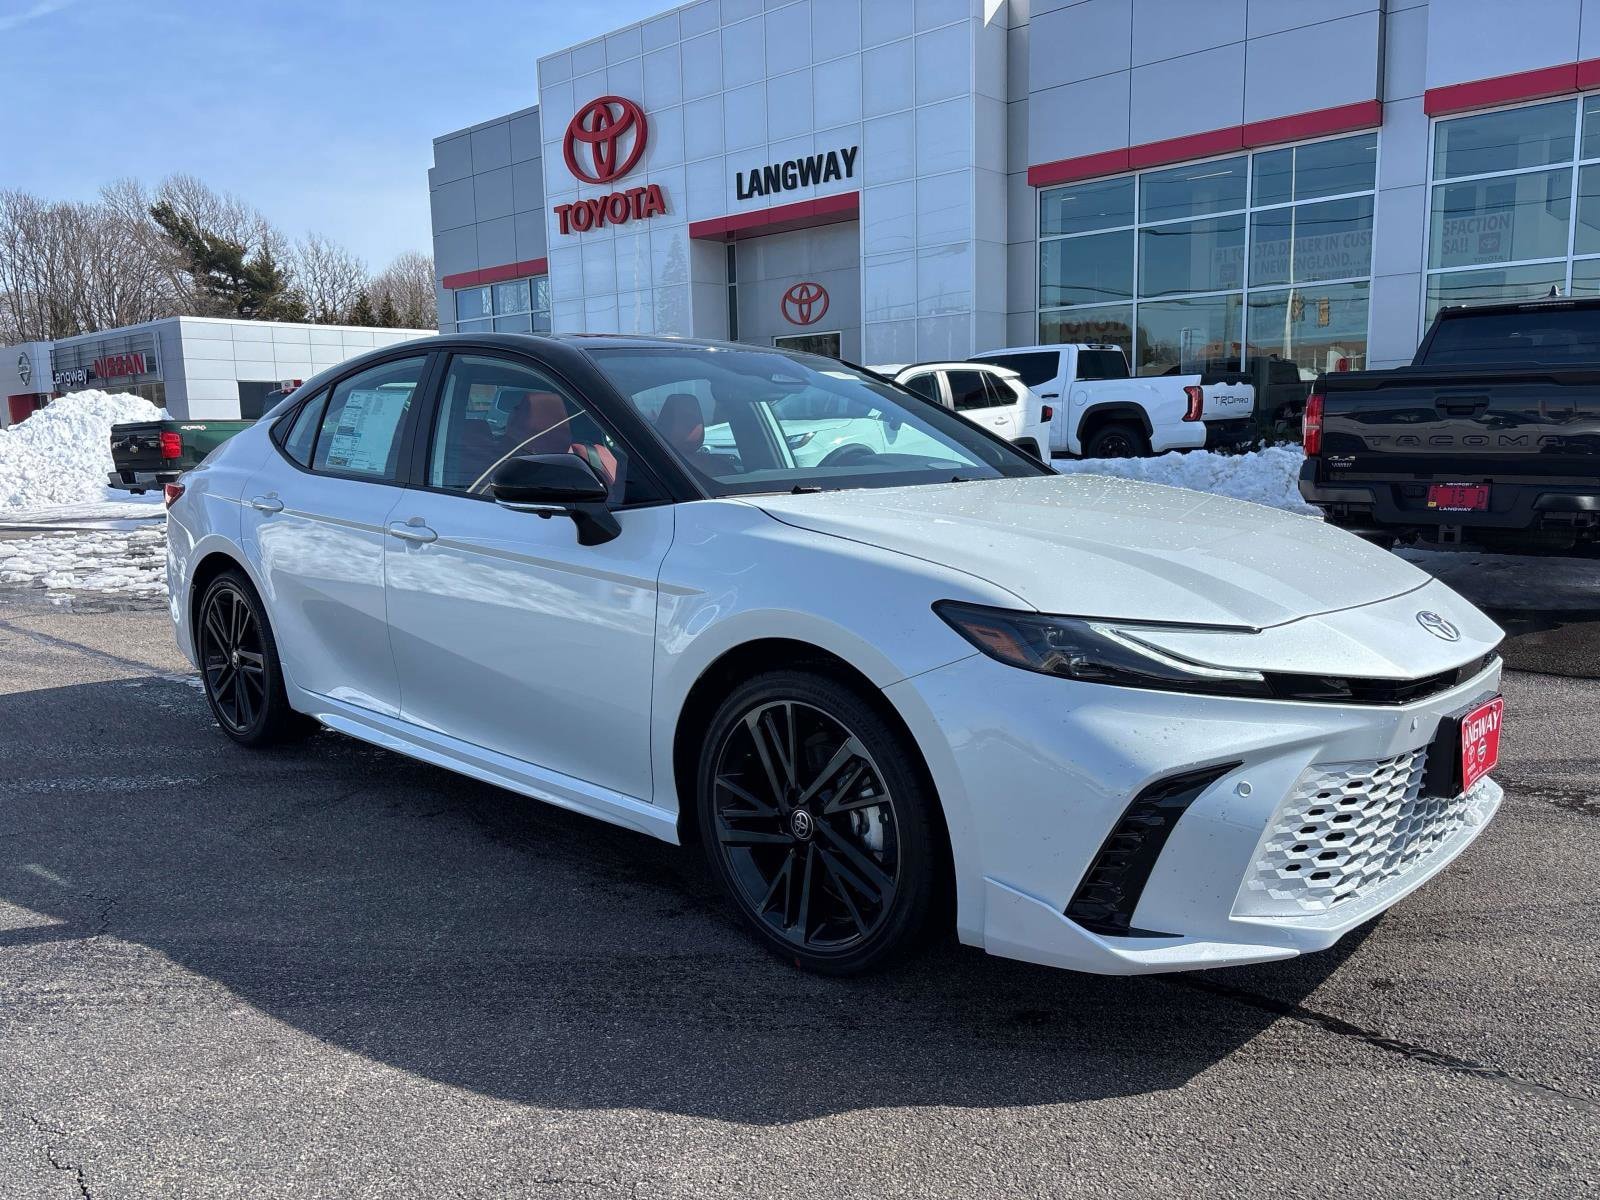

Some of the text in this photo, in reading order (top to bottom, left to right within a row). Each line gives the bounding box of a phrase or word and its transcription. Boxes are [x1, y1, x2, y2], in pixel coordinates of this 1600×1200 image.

[736, 146, 858, 200] LANGWAY
[553, 183, 666, 235] TOYOTA
[1325, 235, 1339, 250] IN
[52, 368, 88, 387] Langway
[94, 352, 147, 378] NISSAN
[1364, 434, 1565, 447] TACOMA
